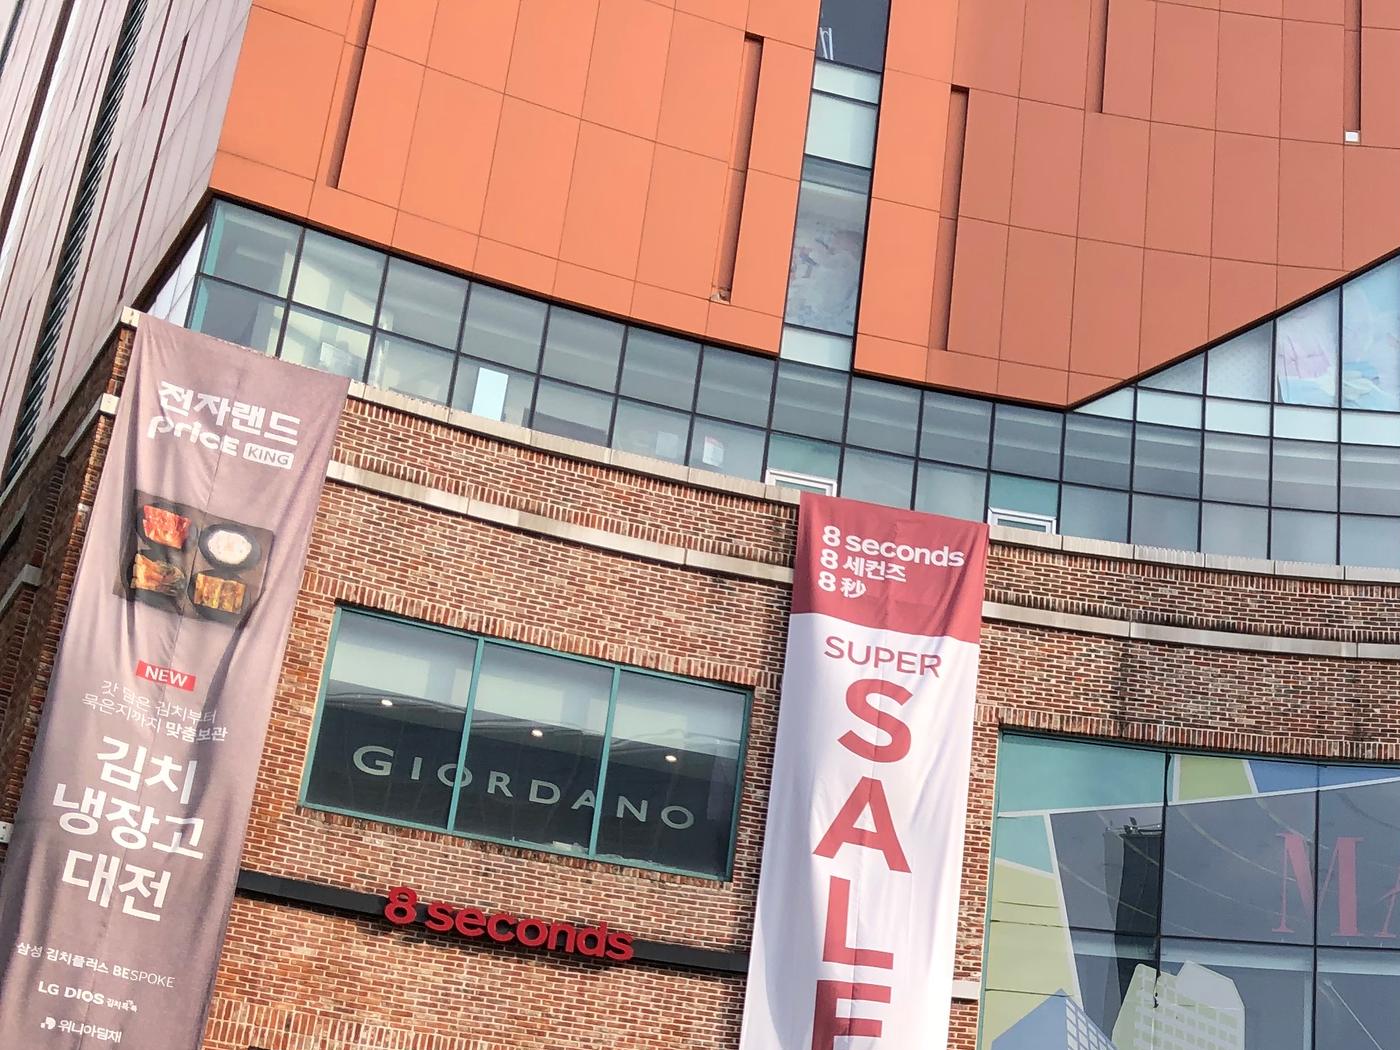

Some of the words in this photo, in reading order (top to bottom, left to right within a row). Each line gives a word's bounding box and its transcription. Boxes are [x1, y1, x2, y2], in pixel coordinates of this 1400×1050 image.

[160, 380, 301, 446] 전자랜드
[248, 445, 291, 465] KING
[820, 549, 839, 570] 8
[843, 556, 907, 583] 세컨즈
[822, 525, 841, 547] 8
[845, 534, 965, 567] seconds
[817, 570, 837, 592] 8
[840, 577, 867, 598] 秒
[145, 665, 188, 687] NEW
[824, 635, 942, 678] SUPER
[155, 701, 217, 725] 김치부터
[165, 721, 229, 743] 맞춤보관
[97, 735, 198, 805] 김치
[352, 744, 696, 830] GIORDANO
[52, 783, 204, 860] 냉장고
[61, 849, 171, 922] 대전
[384, 886, 418, 925] 8
[425, 901, 635, 961] seconds
[16, 941, 43, 959] 삼성
[46, 948, 109, 975] 김치플러스
[112, 964, 176, 989] BESPOKE
[38, 980, 59, 996] LG
[64, 986, 104, 1006] DIOS
